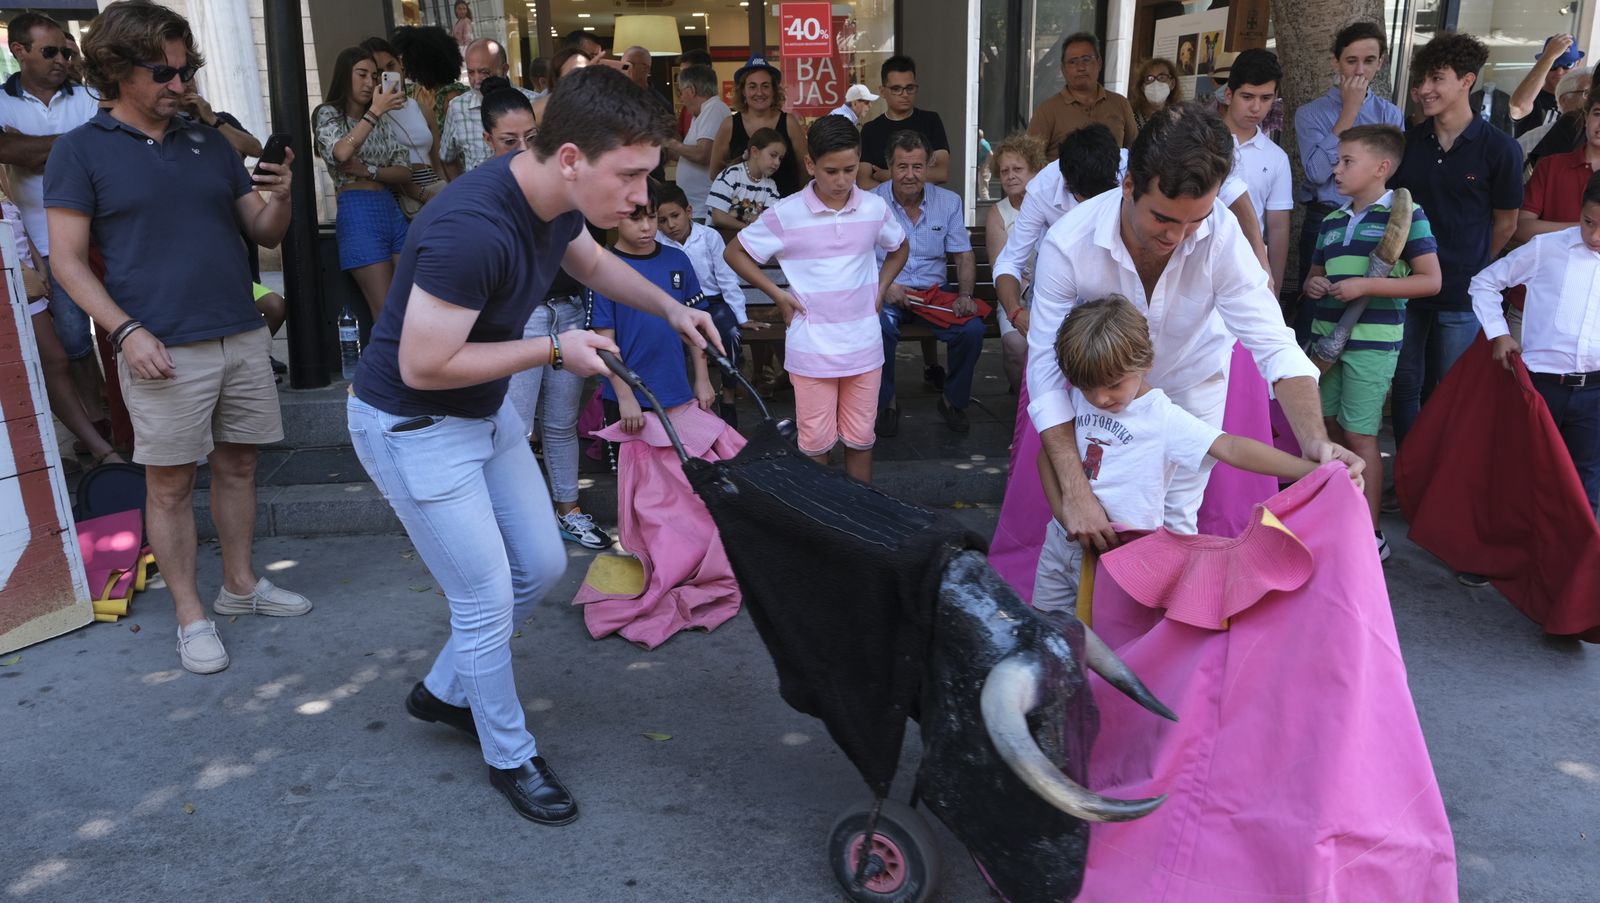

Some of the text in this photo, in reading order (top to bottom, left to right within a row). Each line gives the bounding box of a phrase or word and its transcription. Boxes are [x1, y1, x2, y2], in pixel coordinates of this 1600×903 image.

[784, 17, 829, 40] -40%
[797, 57, 836, 81] BA
[793, 81, 839, 105] JAS
[1076, 413, 1134, 445] MOTORBIKE
